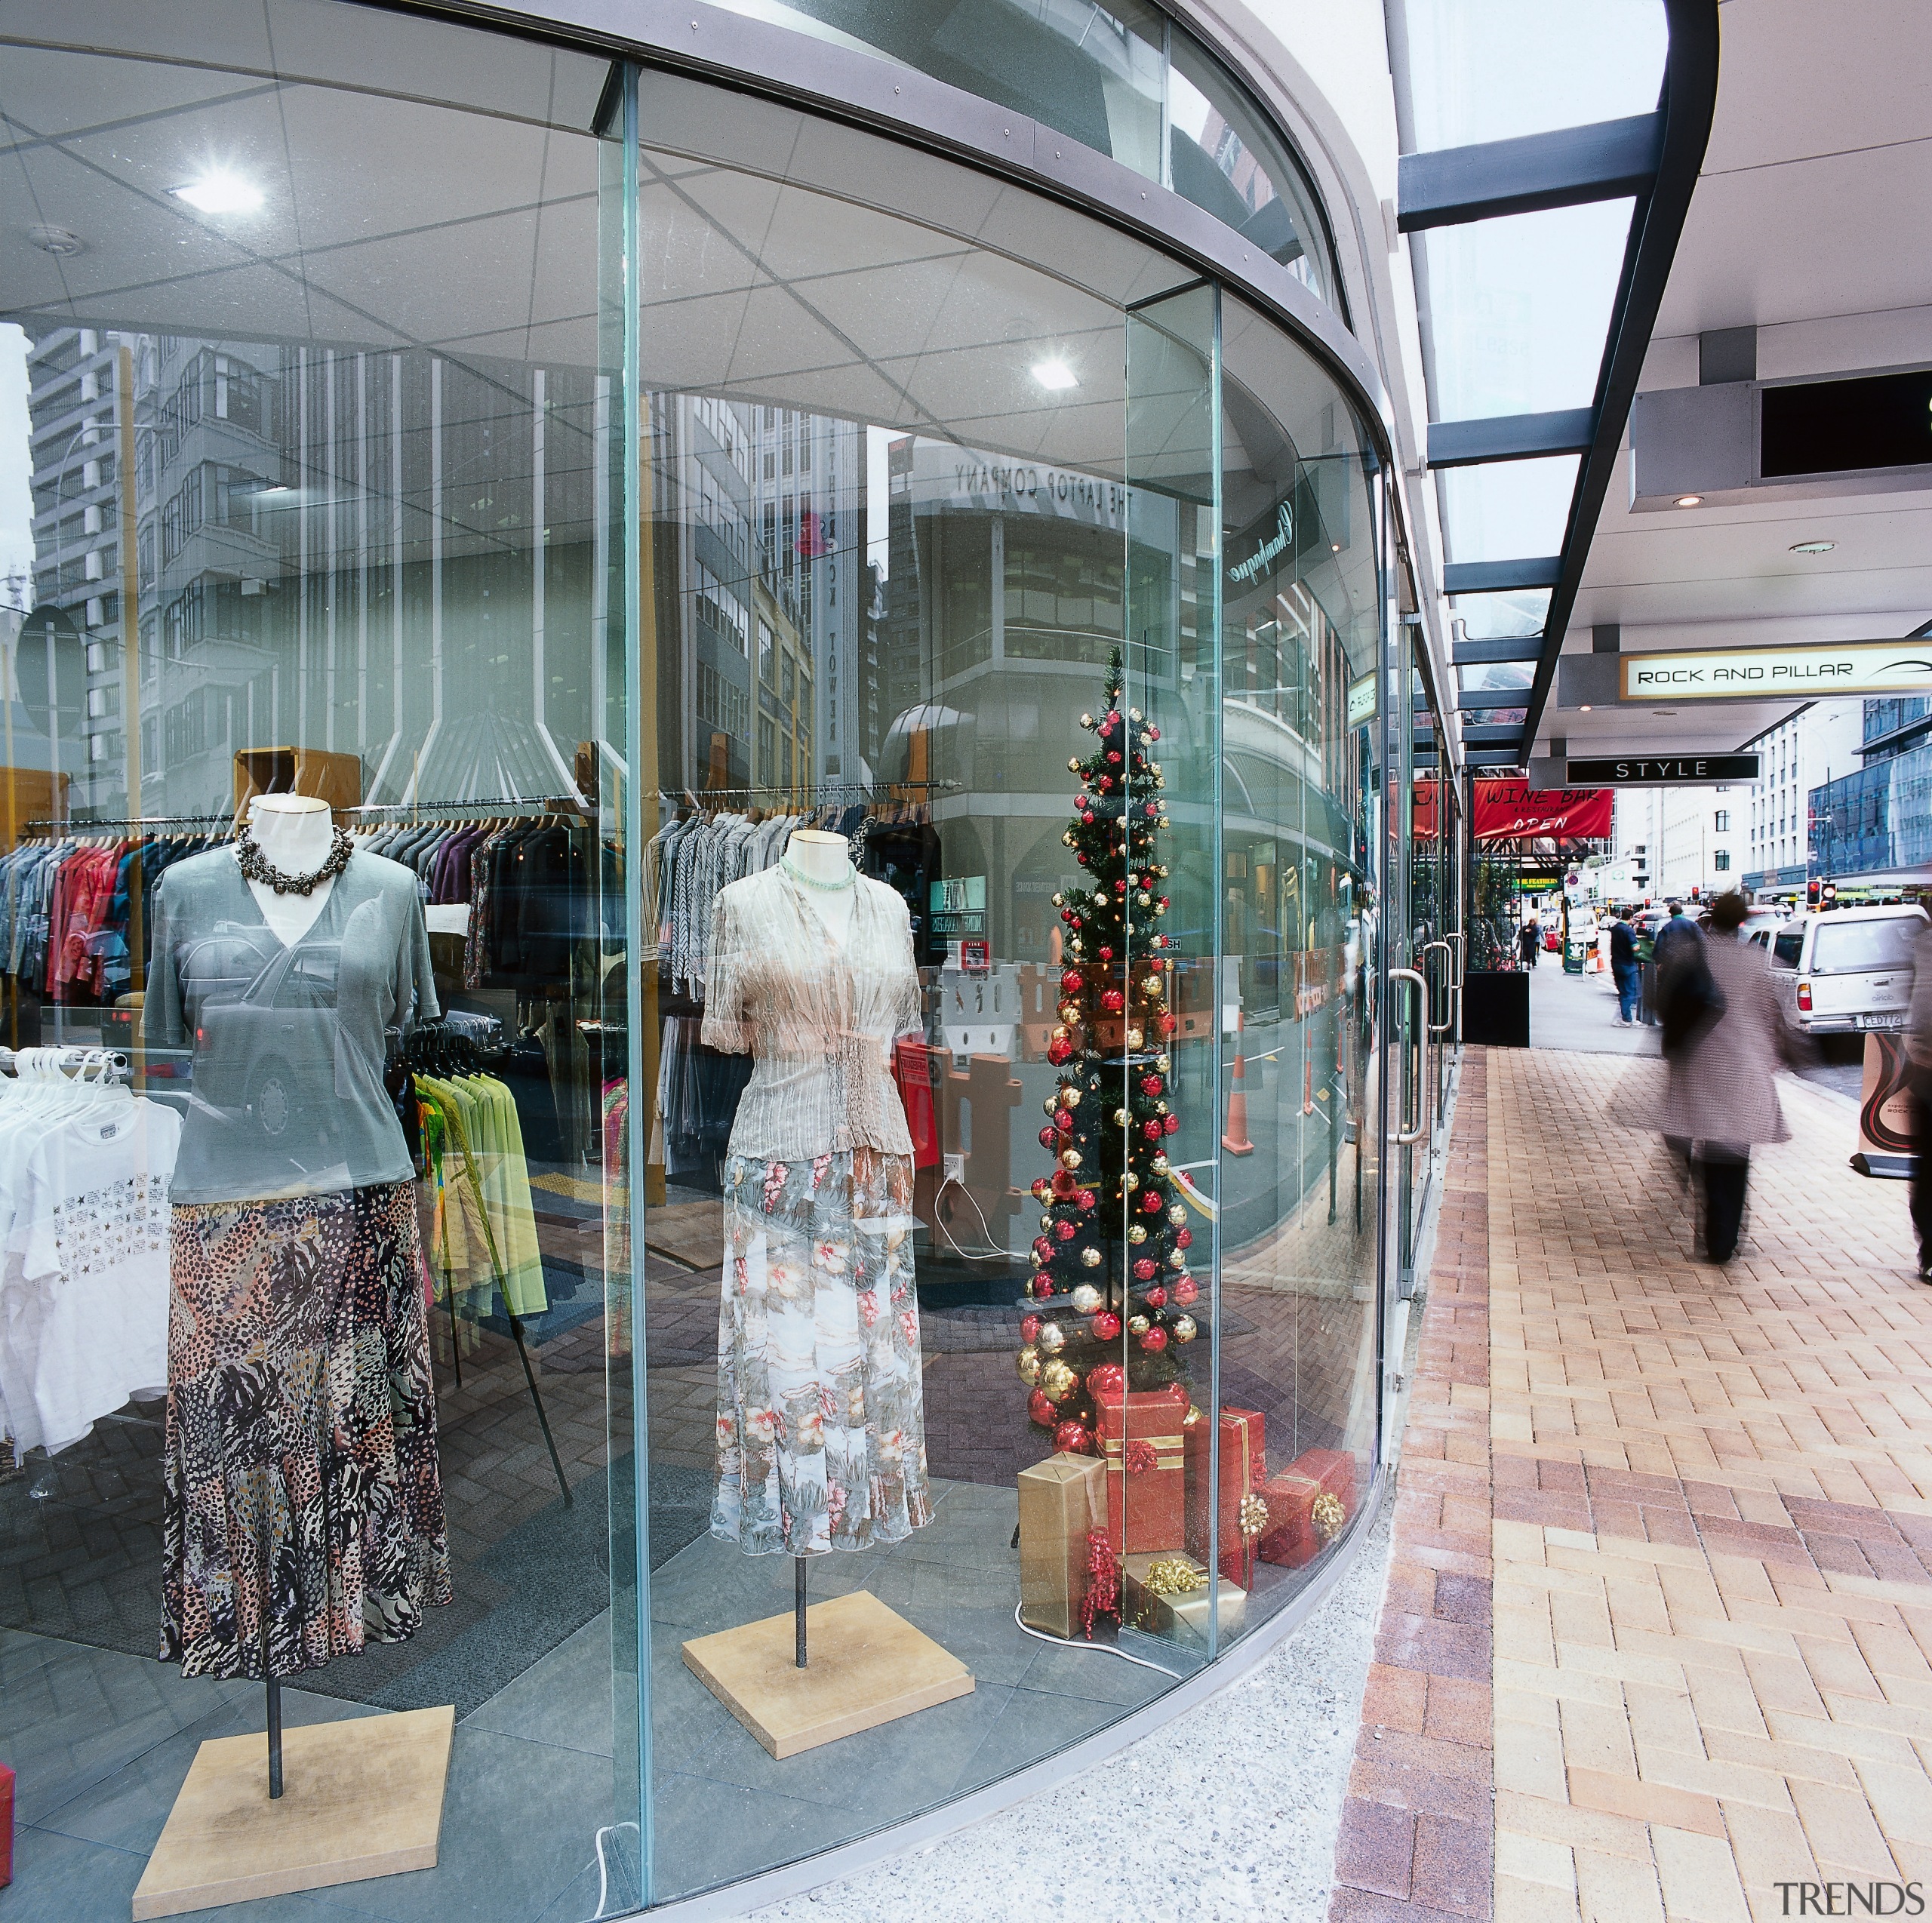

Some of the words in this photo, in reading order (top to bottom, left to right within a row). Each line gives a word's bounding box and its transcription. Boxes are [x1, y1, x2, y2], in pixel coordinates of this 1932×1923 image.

[1638, 669, 1705, 685] ROCK
[1713, 667, 1764, 681] AND
[1772, 663, 1854, 678] PILLAR
[1616, 761, 1707, 778] STYLE
[1487, 788, 1549, 805] WINE
[1560, 789, 1601, 804] BAR
[1513, 817, 1568, 831] OPEN
[1865, 1014, 1900, 1026] CED772
